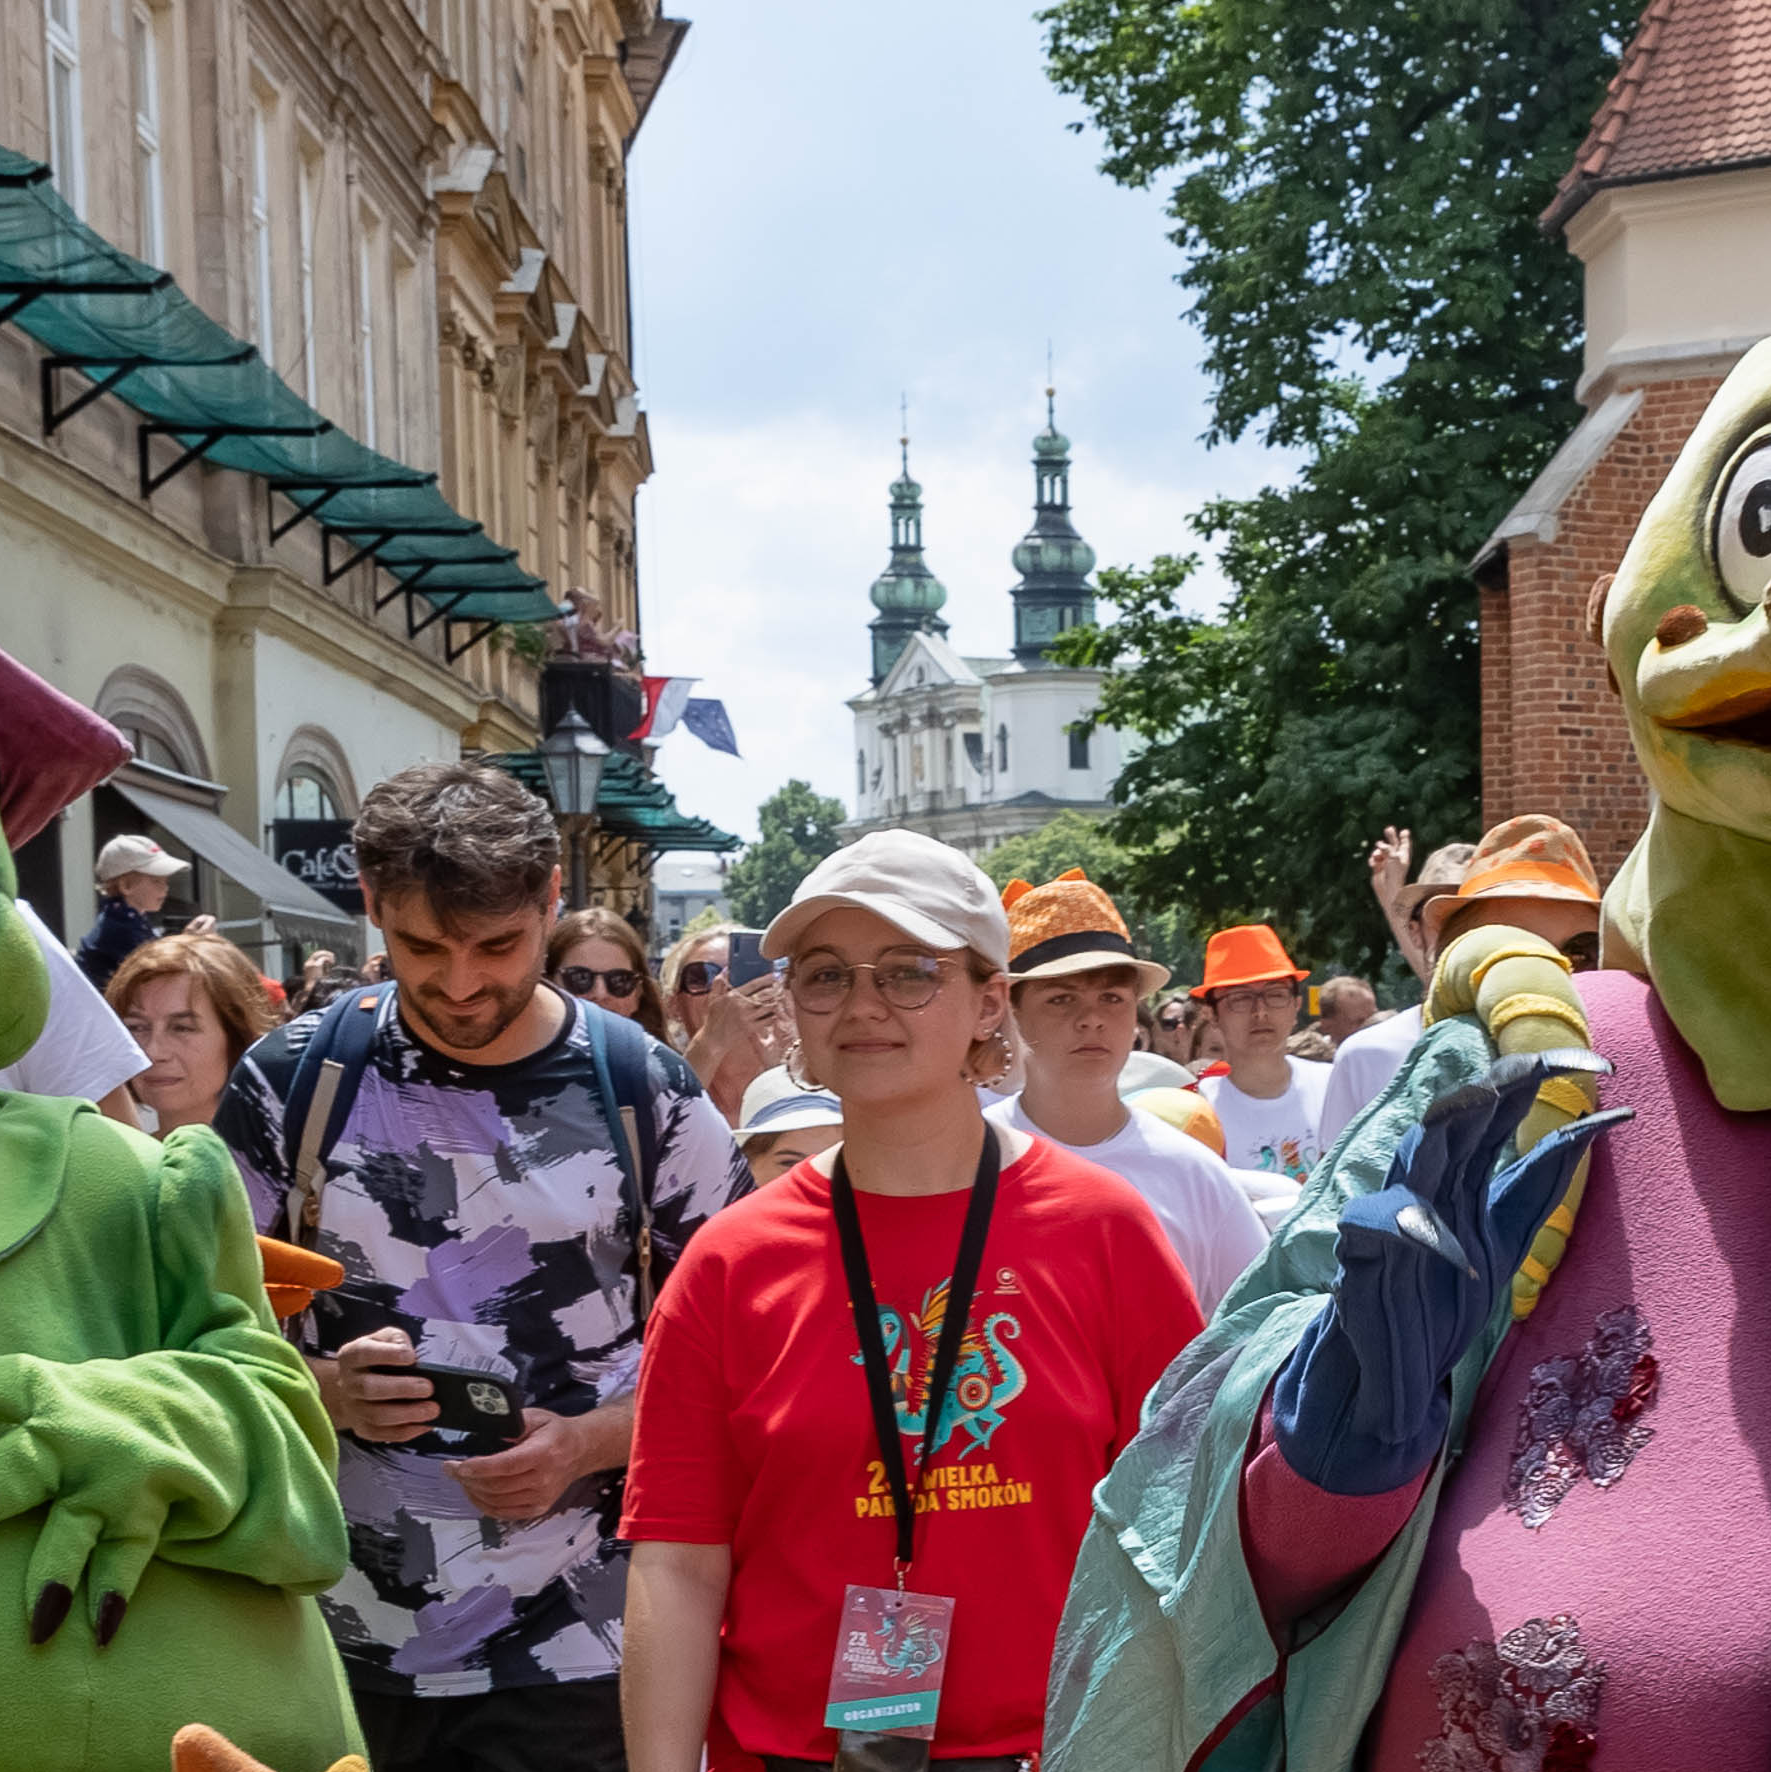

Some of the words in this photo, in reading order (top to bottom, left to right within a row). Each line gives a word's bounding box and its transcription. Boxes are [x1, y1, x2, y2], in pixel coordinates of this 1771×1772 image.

[865, 1459, 915, 1495] 2.
[922, 1463, 1000, 1490] WIELKA
[854, 1491, 941, 1519] PARDA
[946, 1477, 1033, 1511] SMOKÓW
[843, 1702, 922, 1722] ORGANIZATOR
